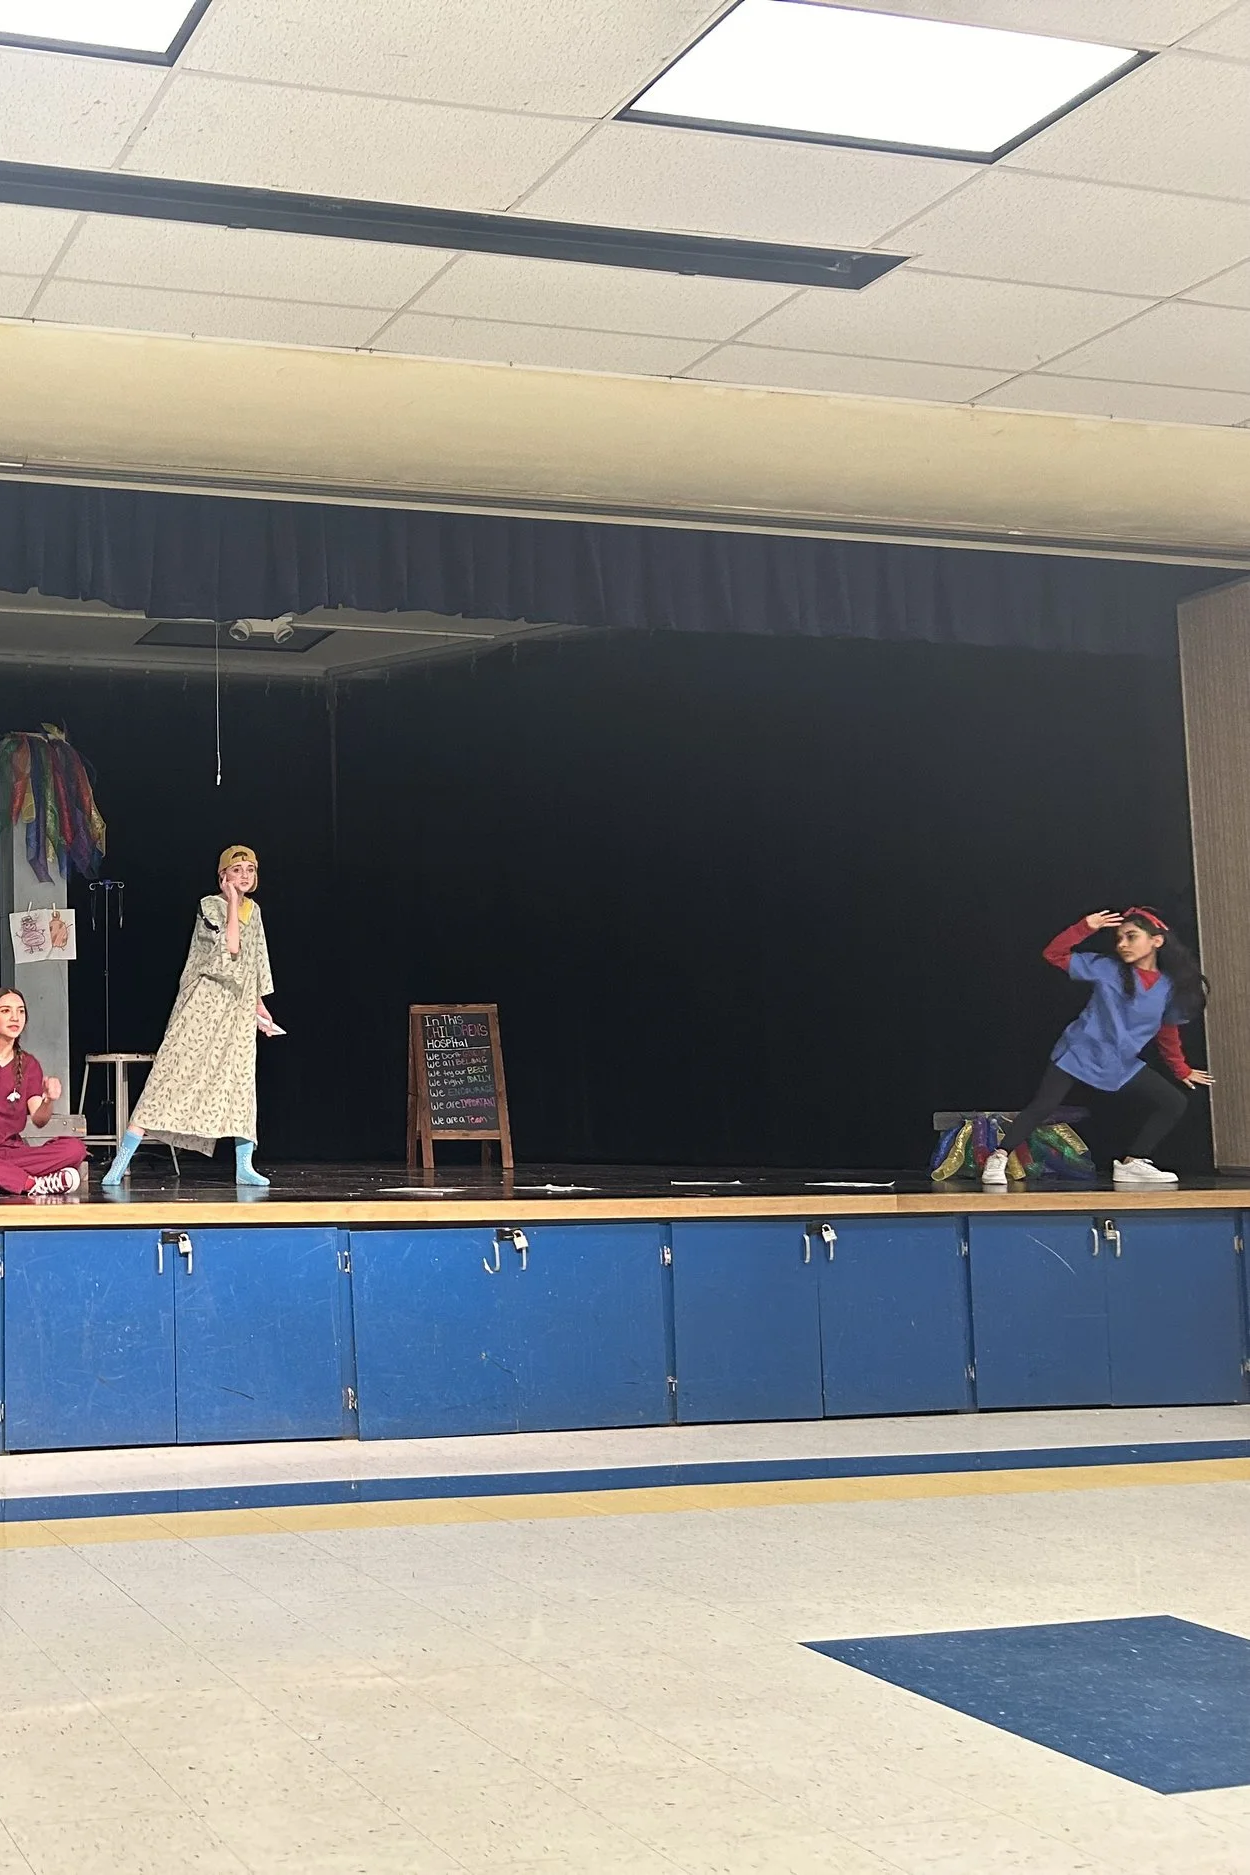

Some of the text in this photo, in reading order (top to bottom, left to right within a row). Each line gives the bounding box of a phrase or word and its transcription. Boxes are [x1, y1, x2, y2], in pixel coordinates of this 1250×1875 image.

[424, 1015, 440, 1027] In
[426, 1052, 441, 1061] We
[427, 1061, 441, 1069] We
[467, 1065, 488, 1075] BEST
[429, 1080, 442, 1088] We
[467, 1075, 492, 1083] DAILY
[430, 1088, 446, 1098] We
[431, 1101, 444, 1111] We
[445, 1100, 461, 1109] are
[432, 1115, 488, 1125] We are a Team
